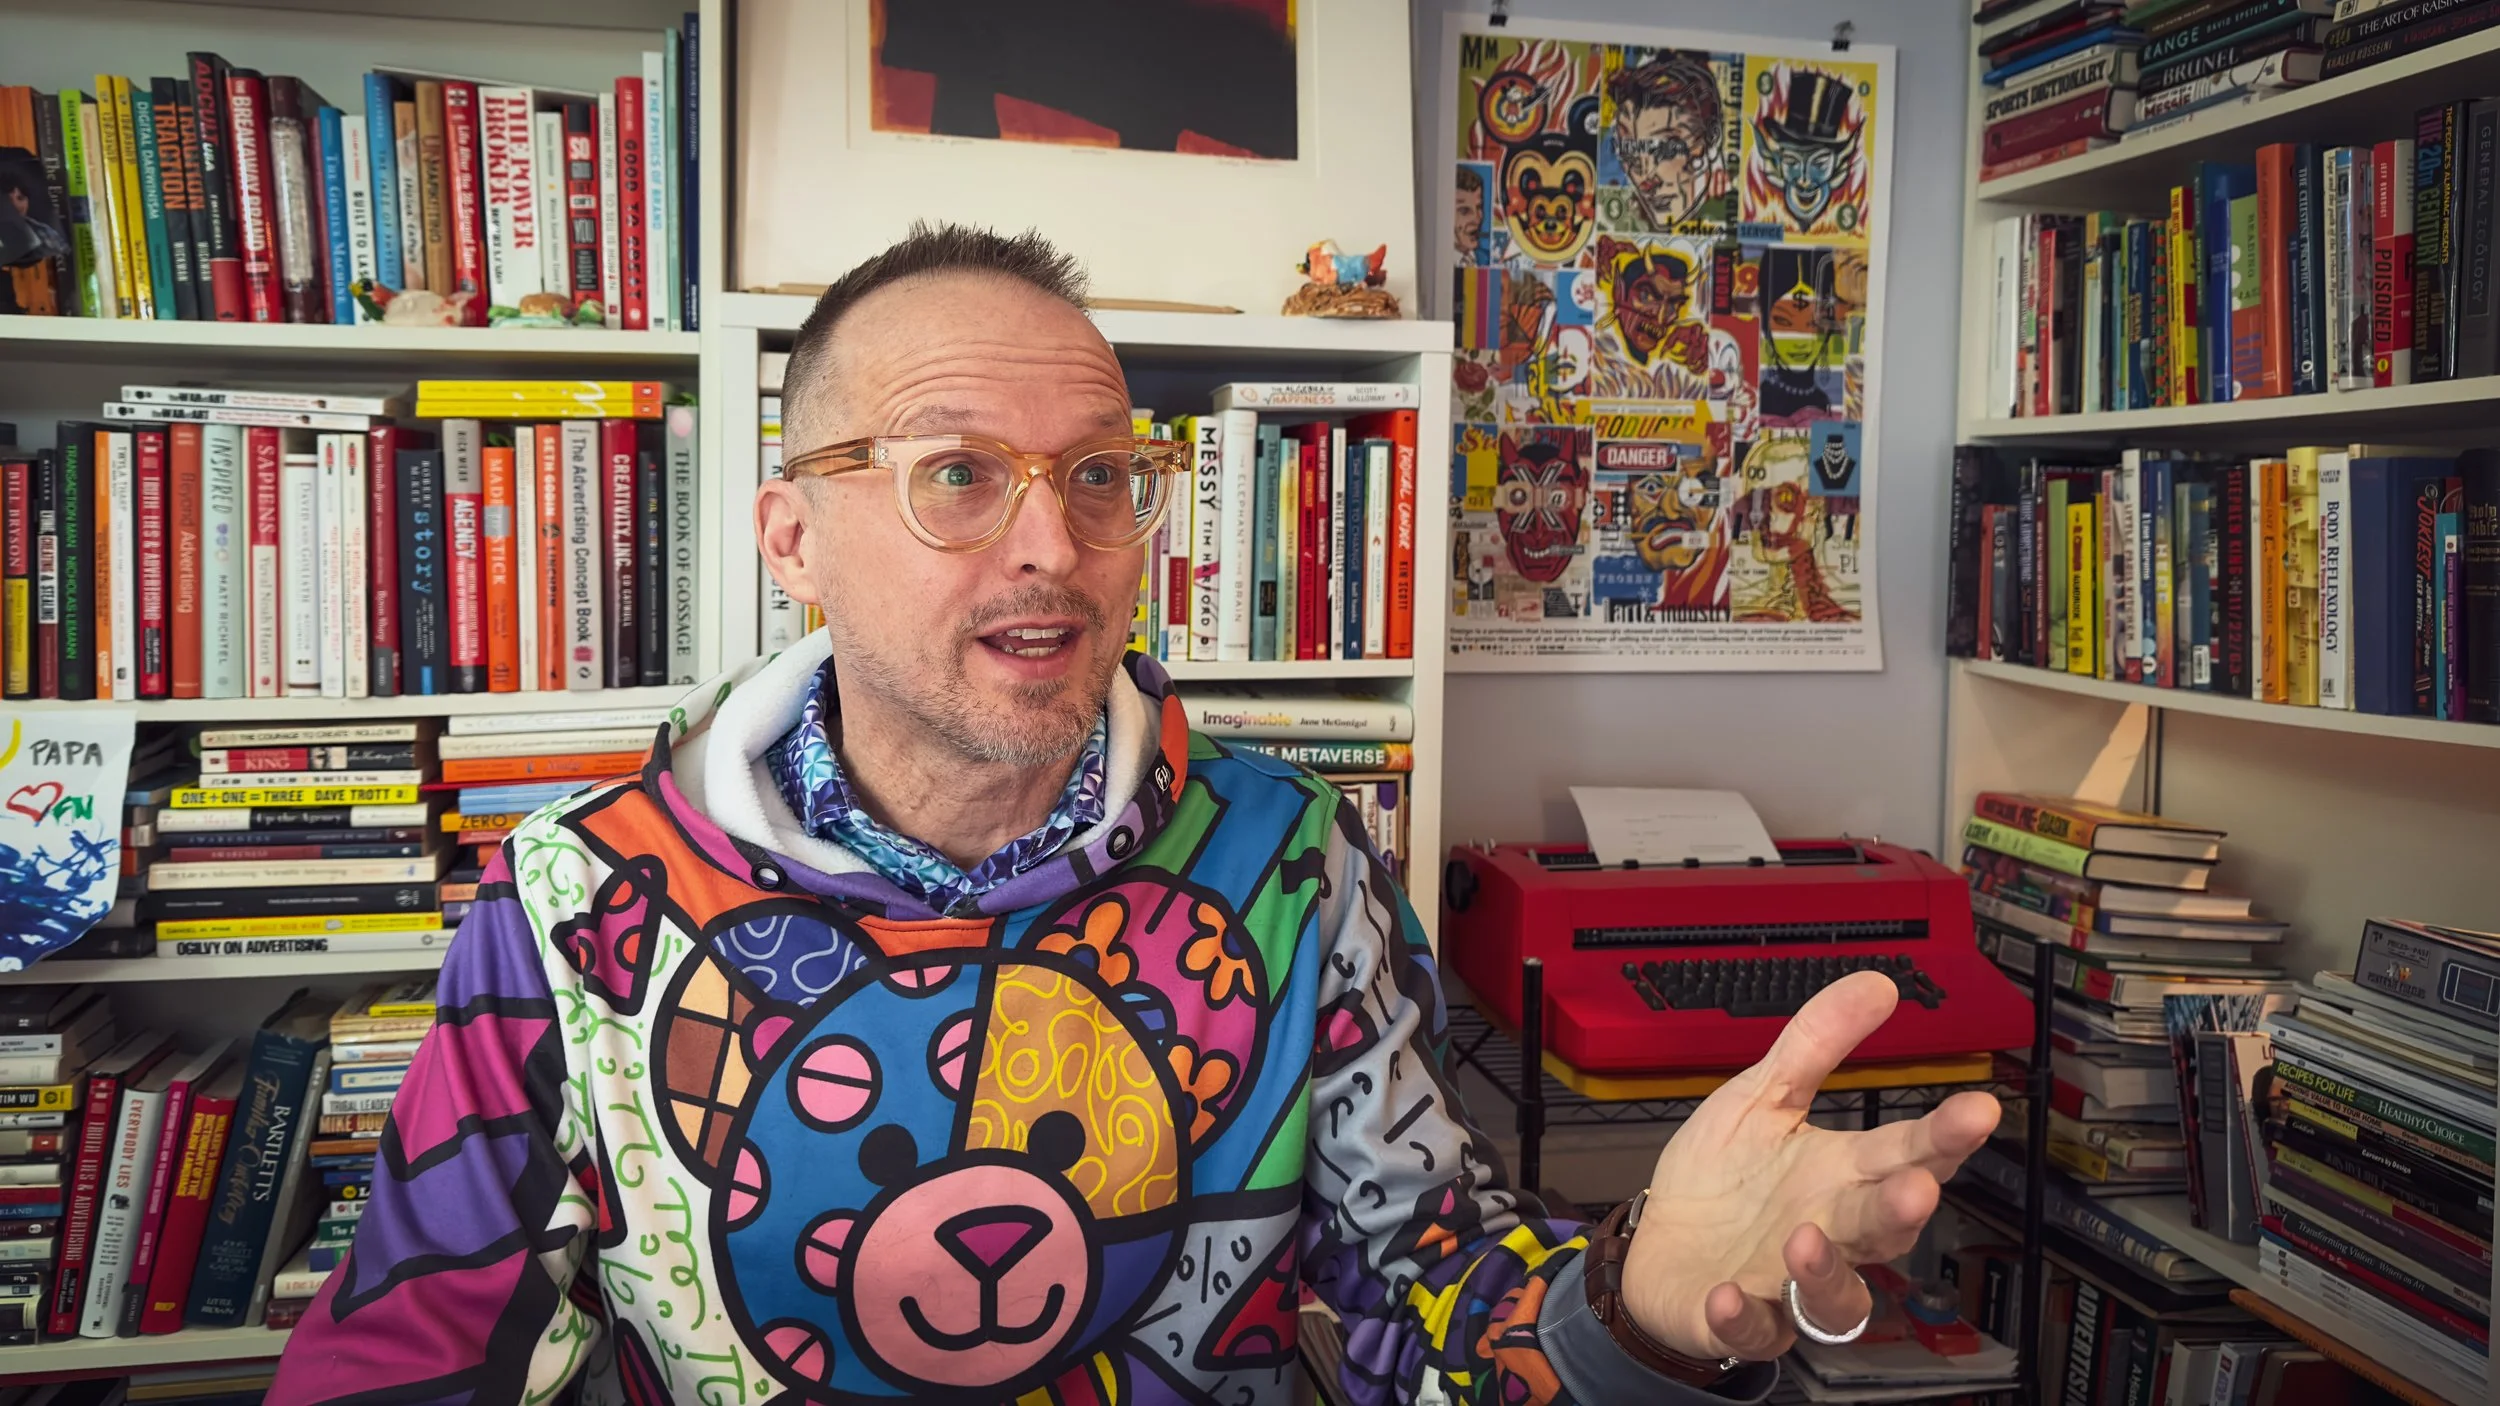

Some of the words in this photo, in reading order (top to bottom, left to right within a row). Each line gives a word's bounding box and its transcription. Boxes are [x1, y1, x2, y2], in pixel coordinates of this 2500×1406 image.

[2142, 26, 2200, 61] RANGE
[2205, 16, 2232, 35] DAVID
[2234, 2, 2271, 25] EPSTEIN
[2357, 19, 2380, 38] THE
[2379, 14, 2403, 33] ART
[2402, 6, 2420, 25] OF
[2161, 46, 2240, 88] BRUNEL
[2356, 39, 2394, 63] HOSSEINI
[195, 60, 219, 146] ADCULT
[648, 91, 660, 113] THE
[1986, 88, 2029, 121] SPORTS
[2030, 59, 2107, 106] DICTIONARY
[137, 101, 152, 149] DIGITAL
[507, 92, 532, 153] THE
[2418, 109, 2443, 146] THE
[2445, 105, 2454, 125] THE
[154, 102, 188, 210] TRACTION
[232, 94, 261, 196] BREAKAWAY
[485, 96, 509, 205] BROKER
[649, 117, 662, 166] PHYSICS
[2443, 126, 2453, 170] PEOPLE'S
[142, 150, 160, 219] DARWINISM
[326, 153, 340, 181] THE
[422, 134, 448, 243] UNMARKETING
[624, 139, 640, 193] GOOD
[651, 169, 662, 185] OF
[2479, 125, 2492, 210] GENERAL
[352, 190, 368, 228] BUILT
[511, 157, 534, 249] POWER
[626, 201, 641, 227] TO
[651, 188, 663, 230] BRAND
[2442, 171, 2452, 216] ALMANAC
[243, 196, 265, 252] BRAND
[355, 232, 368, 249] TO
[2415, 187, 2440, 266] CENTURY
[2440, 217, 2450, 265] PRESENTS
[332, 242, 348, 304] MACHINE
[357, 253, 371, 281] LAS
[627, 235, 643, 300] GREAT
[2374, 248, 2393, 342] POISONED
[457, 430, 469, 455] RICK
[543, 436, 555, 471] SETH
[571, 437, 587, 463] The
[1268, 440, 1278, 464] The
[1606, 445, 1670, 466] DANGER
[8, 470, 22, 504] BILL
[64, 444, 78, 521] TRANSACTION
[209, 438, 233, 515] INSPIRED
[256, 444, 276, 535] SAPIENS
[675, 449, 691, 486] THE
[1200, 426, 1219, 511] MESSY
[1397, 444, 1415, 498] RADICAL
[179, 472, 195, 527] Beyond
[543, 474, 556, 517] GODIN
[570, 465, 590, 544] Advertising
[612, 454, 632, 540] CREATIVITY,
[675, 490, 691, 540] BOOK
[1235, 473, 1247, 546] ELEPHANT
[1264, 465, 1279, 526] Chemistry
[1351, 508, 1361, 522] TO
[2227, 469, 2243, 535] STEPHEN
[8, 508, 22, 568] BRYSON
[64, 522, 78, 548] MAN
[453, 498, 476, 560] AGENCY
[1203, 520, 1214, 547] TIM
[1265, 528, 1276, 540] of
[1397, 501, 1413, 551] CANDOR
[2326, 500, 2340, 544] BODY
[2415, 495, 2438, 580] JOKIEST
[2468, 522, 2498, 537] Bible
[410, 510, 433, 594] story
[491, 535, 507, 585] STICK
[615, 542, 632, 571] INC.
[676, 550, 691, 573] OF
[1350, 525, 1361, 572] CHANGE
[1398, 560, 1409, 578] KIM
[1993, 524, 2006, 570] LOST
[2227, 540, 2243, 575] KING
[64, 556, 78, 612] NICHOLAS
[143, 552, 161, 621] ADVERTISING
[177, 530, 197, 614] Advertising
[216, 574, 228, 608] MATT
[258, 555, 273, 589] Yuval
[571, 547, 590, 606] Concept
[1200, 552, 1214, 627] HARFORD
[40, 584, 55, 620] STEALING
[259, 591, 273, 624] Noah
[676, 576, 692, 657] GOSSAGE
[1233, 581, 1245, 623] BRAIN
[1398, 581, 1410, 611] SCOTT
[2324, 546, 2340, 654] REFLEXOLOGY
[64, 613, 78, 660] LEMANN
[217, 611, 229, 665] RICHTEL
[259, 626, 274, 665] Harari
[575, 608, 592, 642] Book
[2227, 596, 2243, 675] 11/22/63
[1202, 710, 1292, 729] Imaginable
[1299, 716, 1320, 727] Jane
[1321, 716, 1368, 729] McGonigal
[29, 739, 103, 766] PAPA
[244, 758, 290, 770] KING
[1281, 747, 1386, 765] METAVERSE
[181, 791, 208, 804] ONE
[221, 790, 248, 803] ONE
[263, 788, 305, 802] THREE
[314, 788, 348, 802] DAVE
[350, 788, 390, 801] TROTT
[460, 814, 508, 829] ZERO
[177, 941, 222, 956] OGILVY
[224, 940, 243, 954] ON
[245, 937, 328, 955] ADVERTISING
[18, 1093, 37, 1104] WU
[2276, 1062, 2315, 1087] RECIPES
[2315, 1076, 2335, 1095] FOR
[2336, 1084, 2356, 1102] LIFE
[320, 1116, 352, 1133] MIKE
[2284, 1082, 2309, 1100] ADDING
[2309, 1090, 2332, 1107] VALUE
[2342, 1104, 2362, 1119] YOUR
[2361, 1112, 2383, 1129] HOME
[2377, 1099, 2423, 1129] HEALTHY
[2425, 1119, 2465, 1146] CHOICE
[120, 1099, 145, 1164] EVERYBODY
[254, 1104, 291, 1201] BARTLETT'S
[117, 1164, 132, 1189] LIES
[2361, 1148, 2385, 1165] Careers
[2385, 1157, 2393, 1168] by
[2392, 1160, 2412, 1175] Design
[65, 1194, 92, 1261] ADVERTISING
[2298, 1221, 2349, 1255] Transforming
[2349, 1246, 2375, 1267] Vision:
[2378, 1262, 2403, 1281] Writers
[2412, 1279, 2427, 1292] Art
[2066, 1280, 2100, 1406] ADVERTISIN
[2128, 1376, 2142, 1406] Histo
[2130, 1363, 2143, 1377] A
